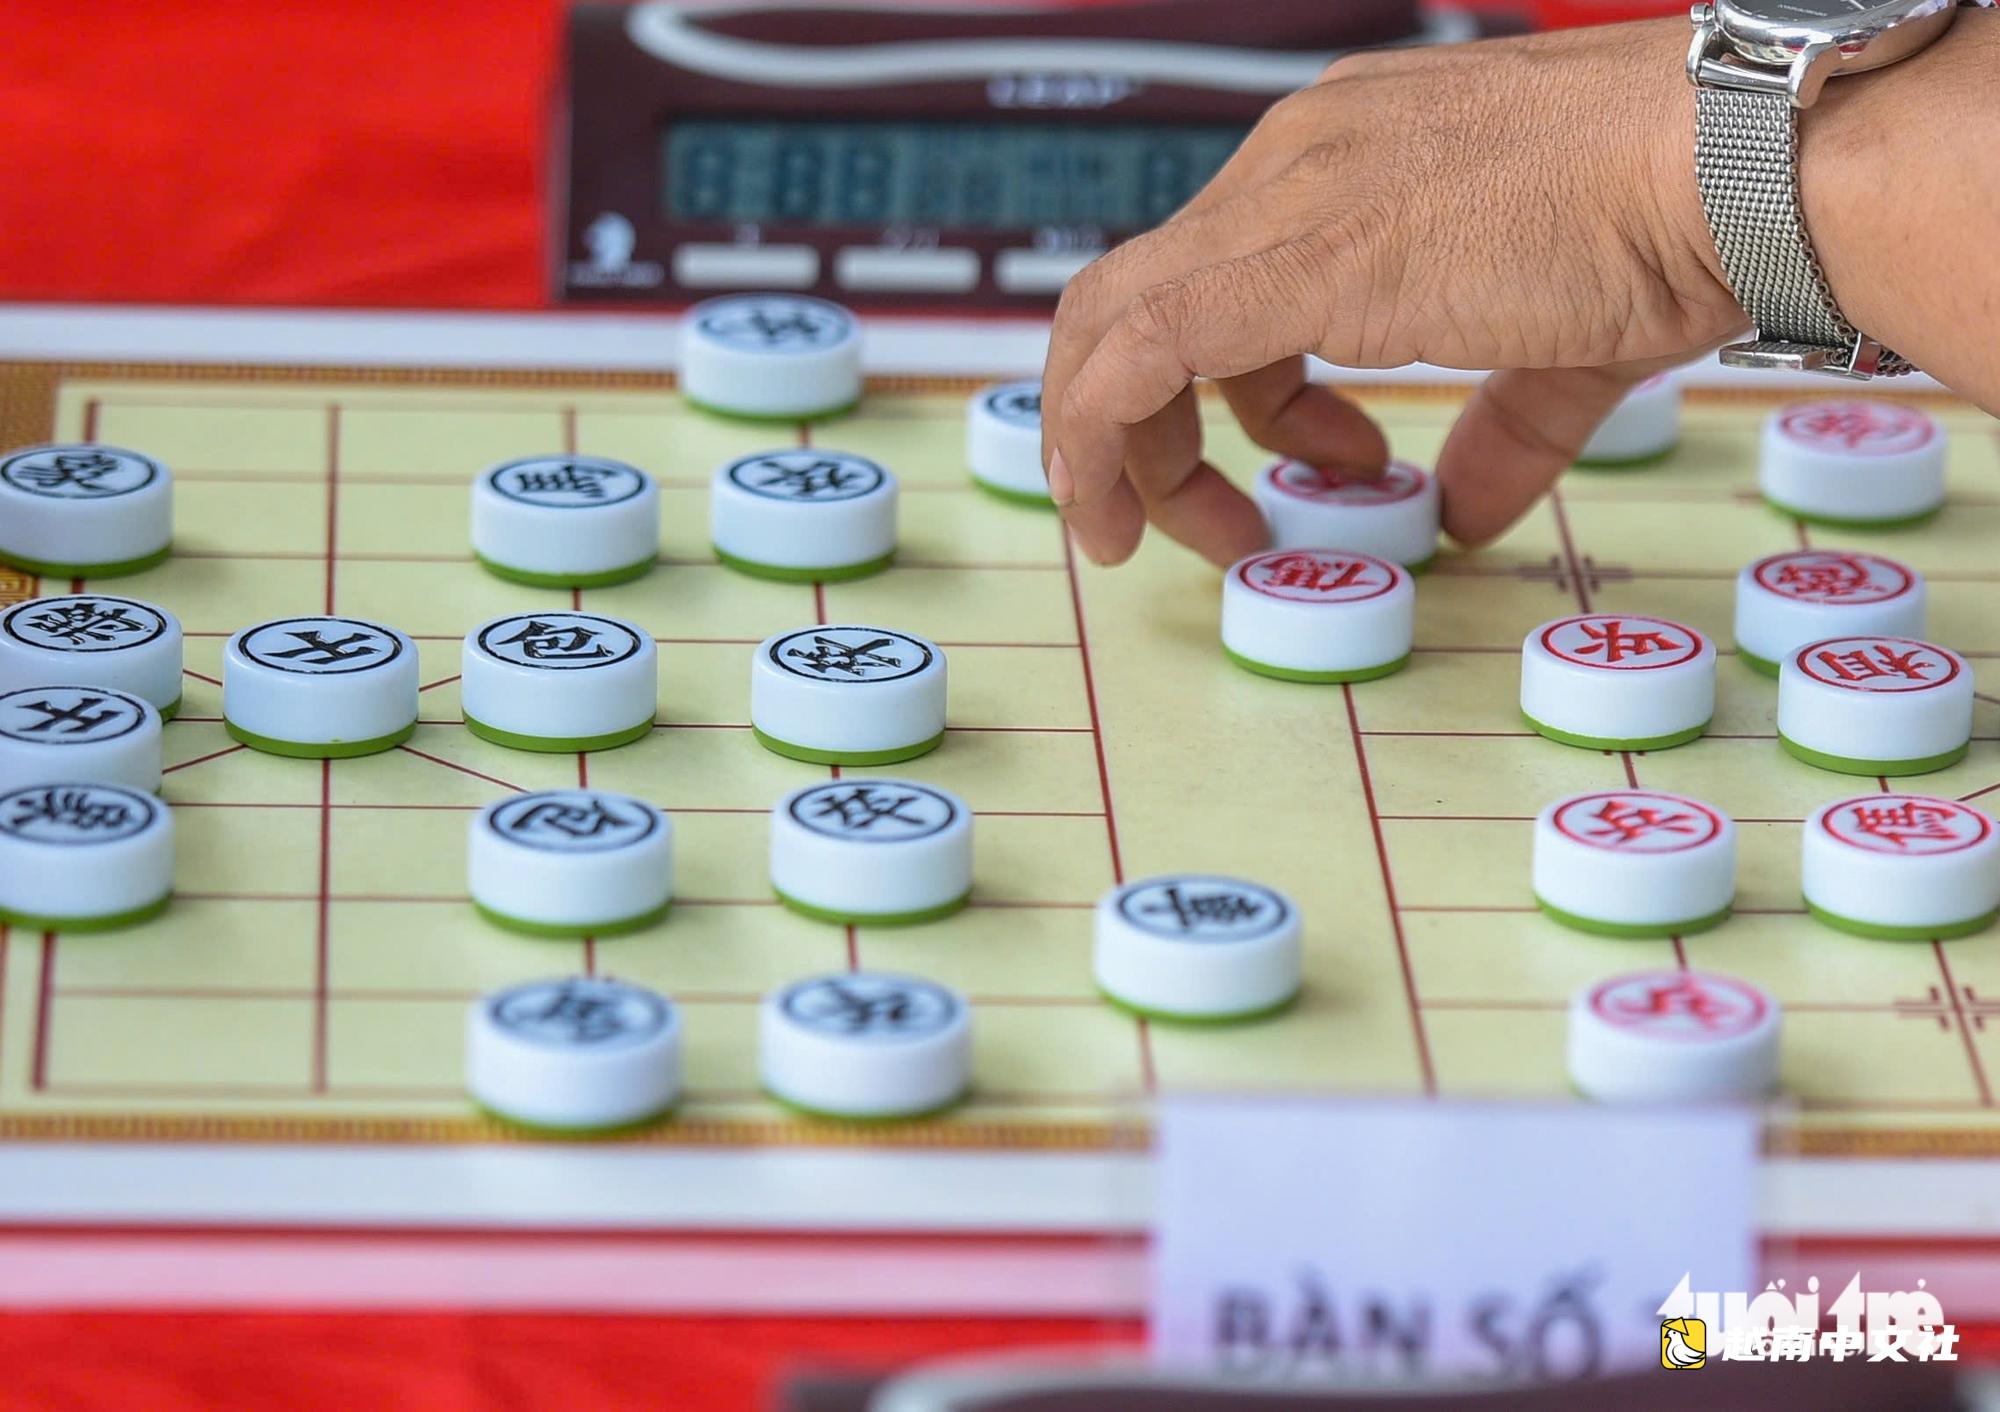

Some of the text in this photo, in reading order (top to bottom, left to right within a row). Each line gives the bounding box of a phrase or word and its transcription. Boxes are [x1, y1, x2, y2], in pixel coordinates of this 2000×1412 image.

[516, 463, 620, 501] 馬
[26, 601, 145, 645] 將
[1573, 620, 1684, 663] 兵
[263, 630, 382, 665] 士
[1816, 643, 1936, 682] 相
[15, 696, 124, 734] 士
[1588, 799, 1698, 844] 兵
[1852, 801, 1962, 846] 傌
